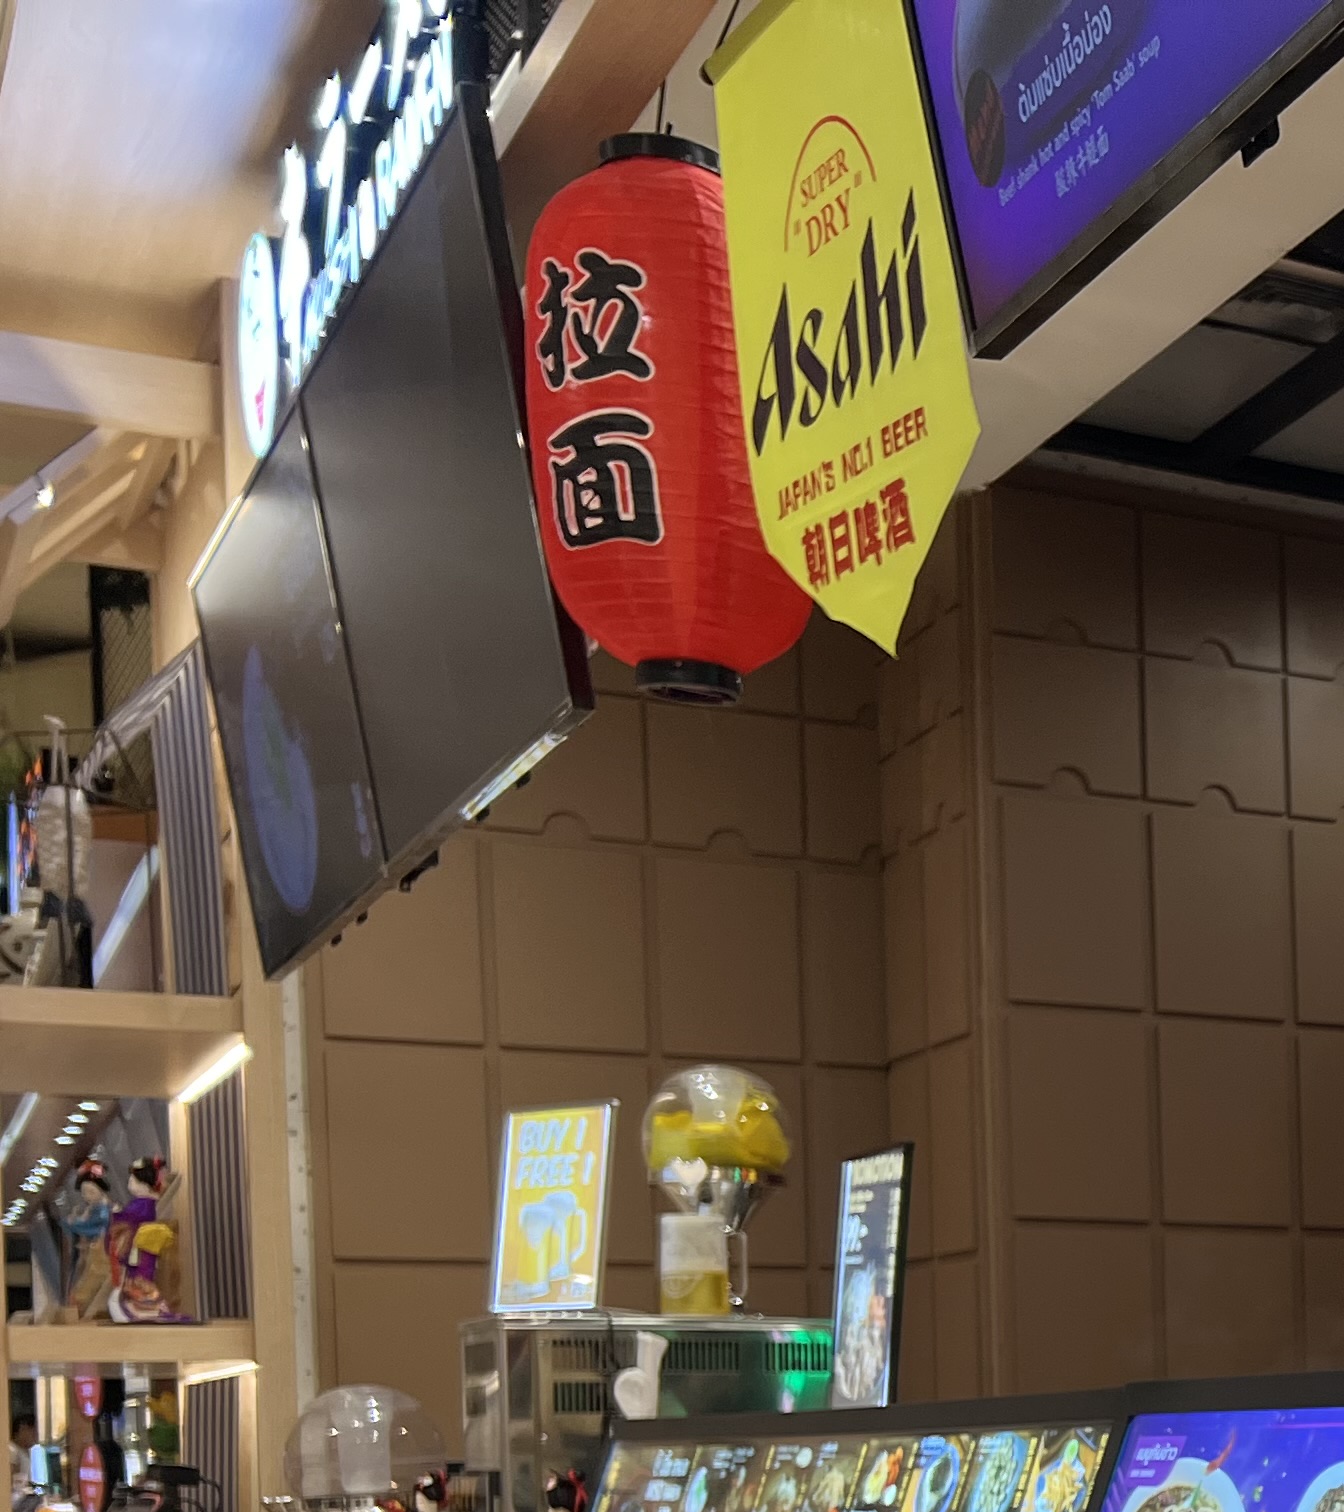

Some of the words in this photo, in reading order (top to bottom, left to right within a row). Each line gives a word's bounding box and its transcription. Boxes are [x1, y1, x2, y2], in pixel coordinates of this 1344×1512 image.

[800, 148, 849, 208] SUPER
[804, 188, 853, 257] DRY
[752, 186, 928, 457] Asahi
[536, 248, 665, 550] 拉面
[777, 459, 836, 521] JAPAN'S
[842, 440, 875, 485] NO.1
[881, 406, 929, 459] BEER
[802, 477, 917, 593] 朝日啤酒
[513, 1152, 578, 1190] FREE
[518, 1119, 570, 1154] BUY
